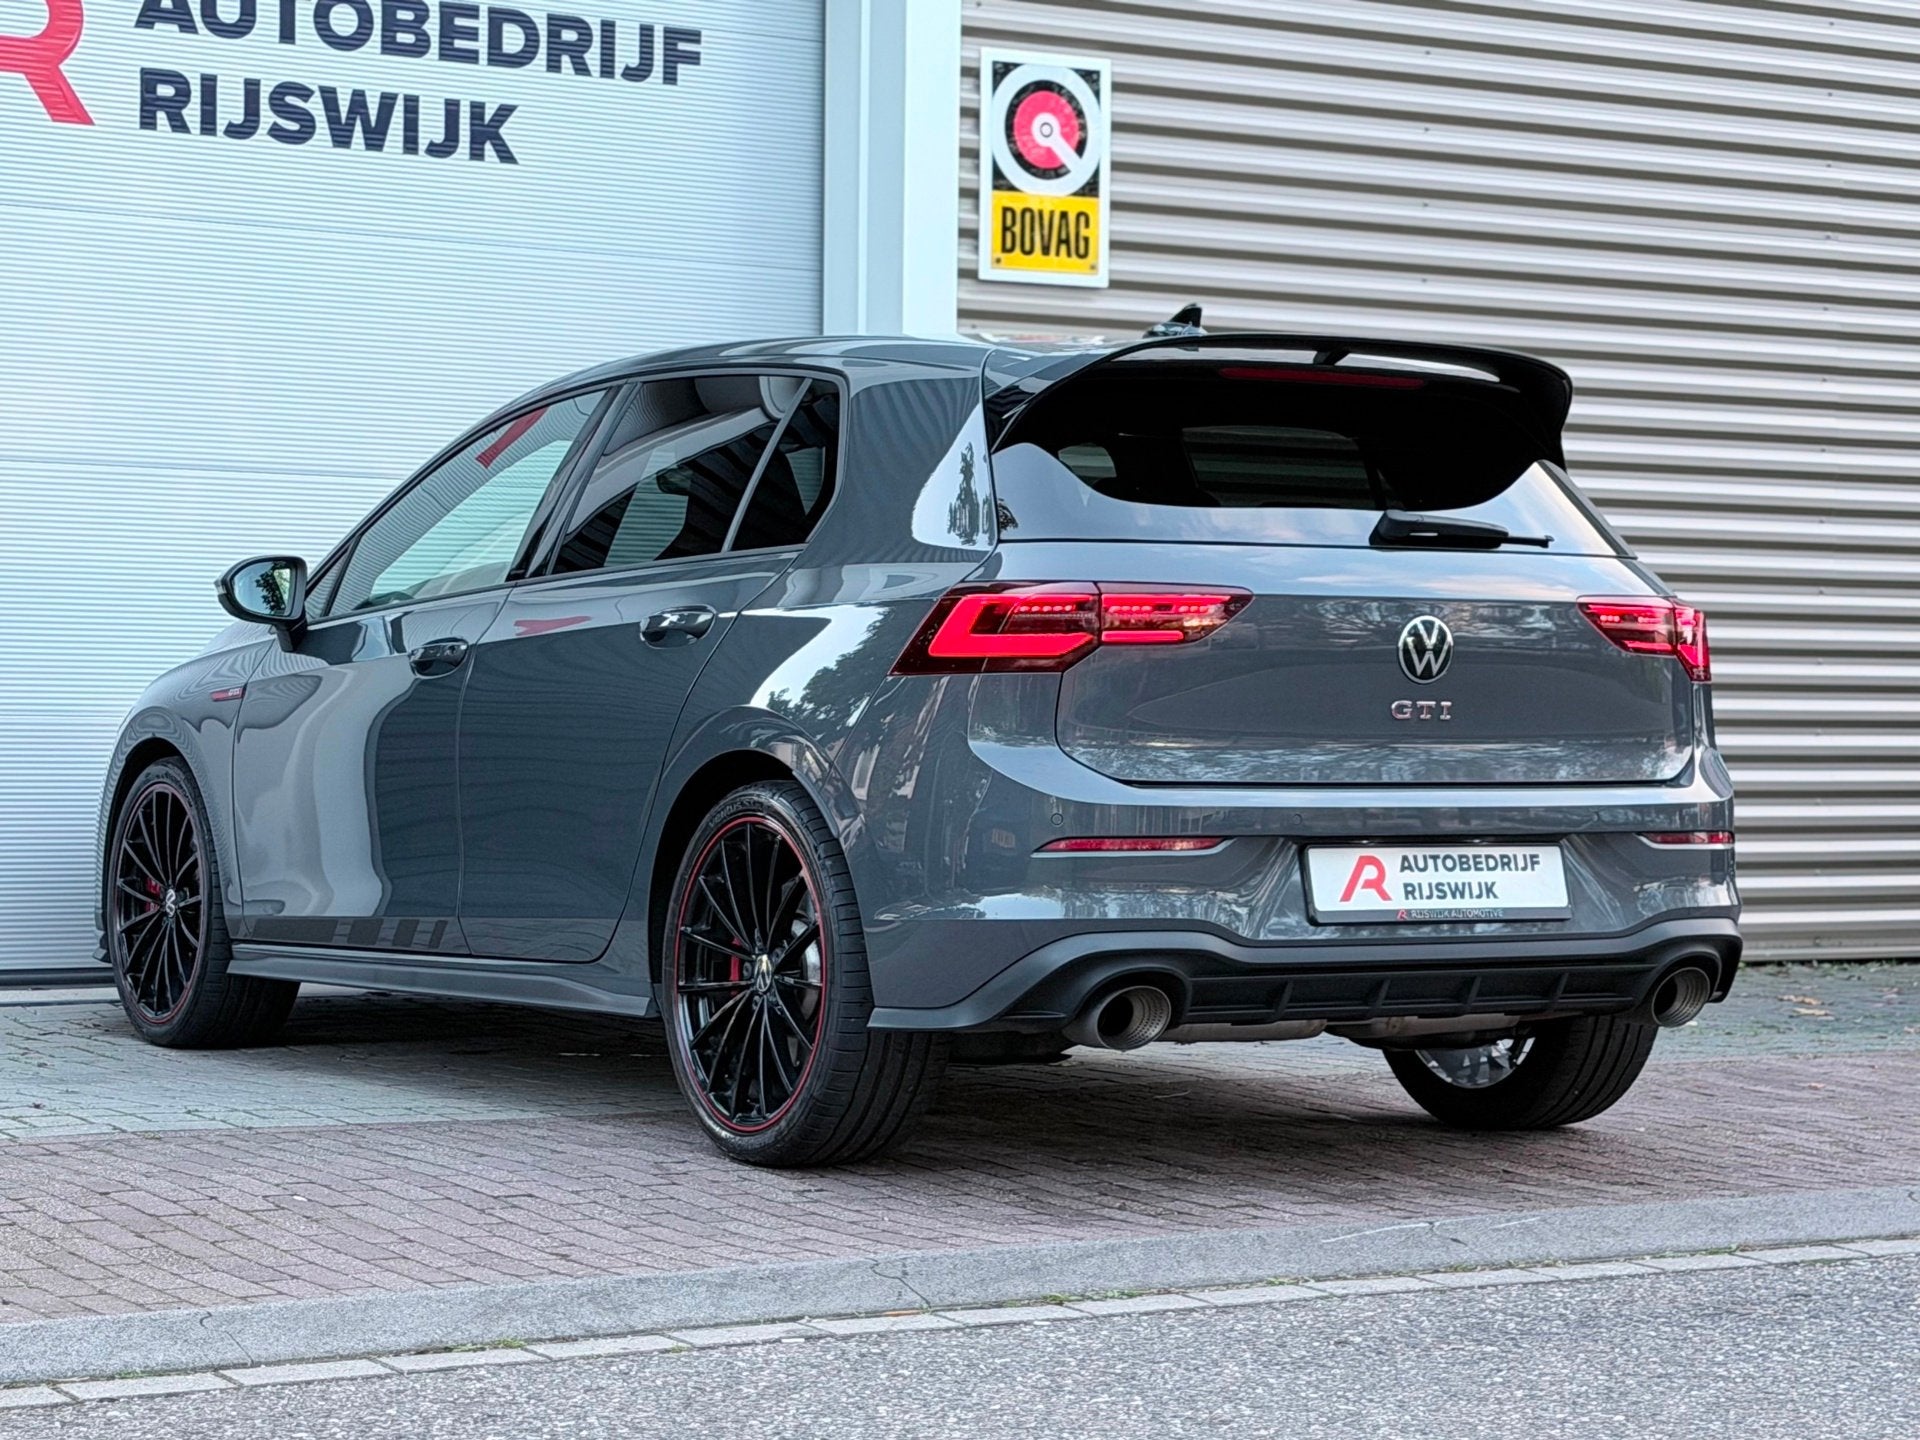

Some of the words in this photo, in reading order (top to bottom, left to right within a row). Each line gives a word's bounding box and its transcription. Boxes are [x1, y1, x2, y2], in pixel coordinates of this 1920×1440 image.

[139, 67, 519, 164] RIJSWIJK
[1000, 206, 1090, 259] BOVAG
[1391, 700, 1453, 720] GTI
[1399, 854, 1541, 873] AUTOBEDRIJF
[1403, 881, 1499, 900] RIJSWIJK
[1450, 909, 1504, 919] AUTOMOTIVE
